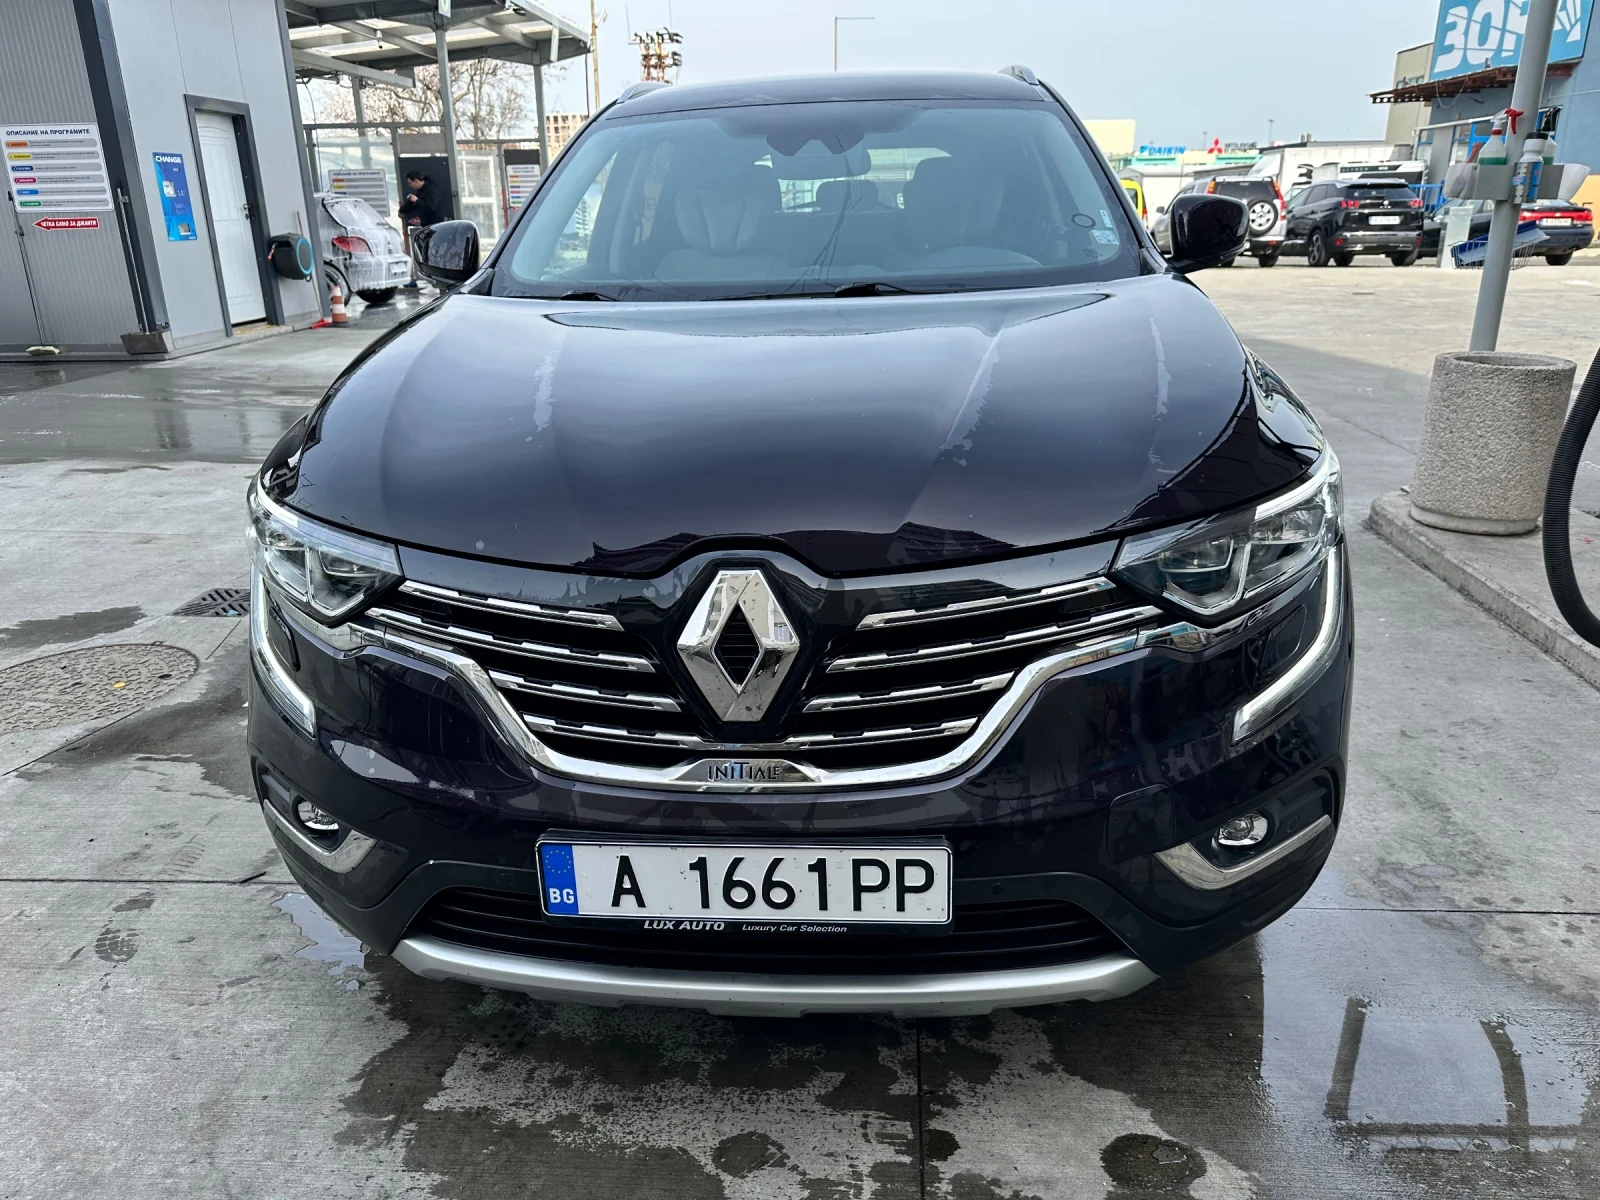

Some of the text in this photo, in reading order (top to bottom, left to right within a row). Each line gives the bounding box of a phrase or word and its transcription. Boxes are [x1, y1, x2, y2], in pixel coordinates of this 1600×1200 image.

[1148, 146, 1186, 156] DAIKIN
[155, 155, 182, 164] CHANGE
[708, 761, 781, 780] INITIALE
[611, 855, 646, 908] A
[549, 888, 575, 904] BG
[643, 920, 675, 930] LUX
[678, 921, 726, 931] AUTO
[742, 924, 777, 932] Luxury
